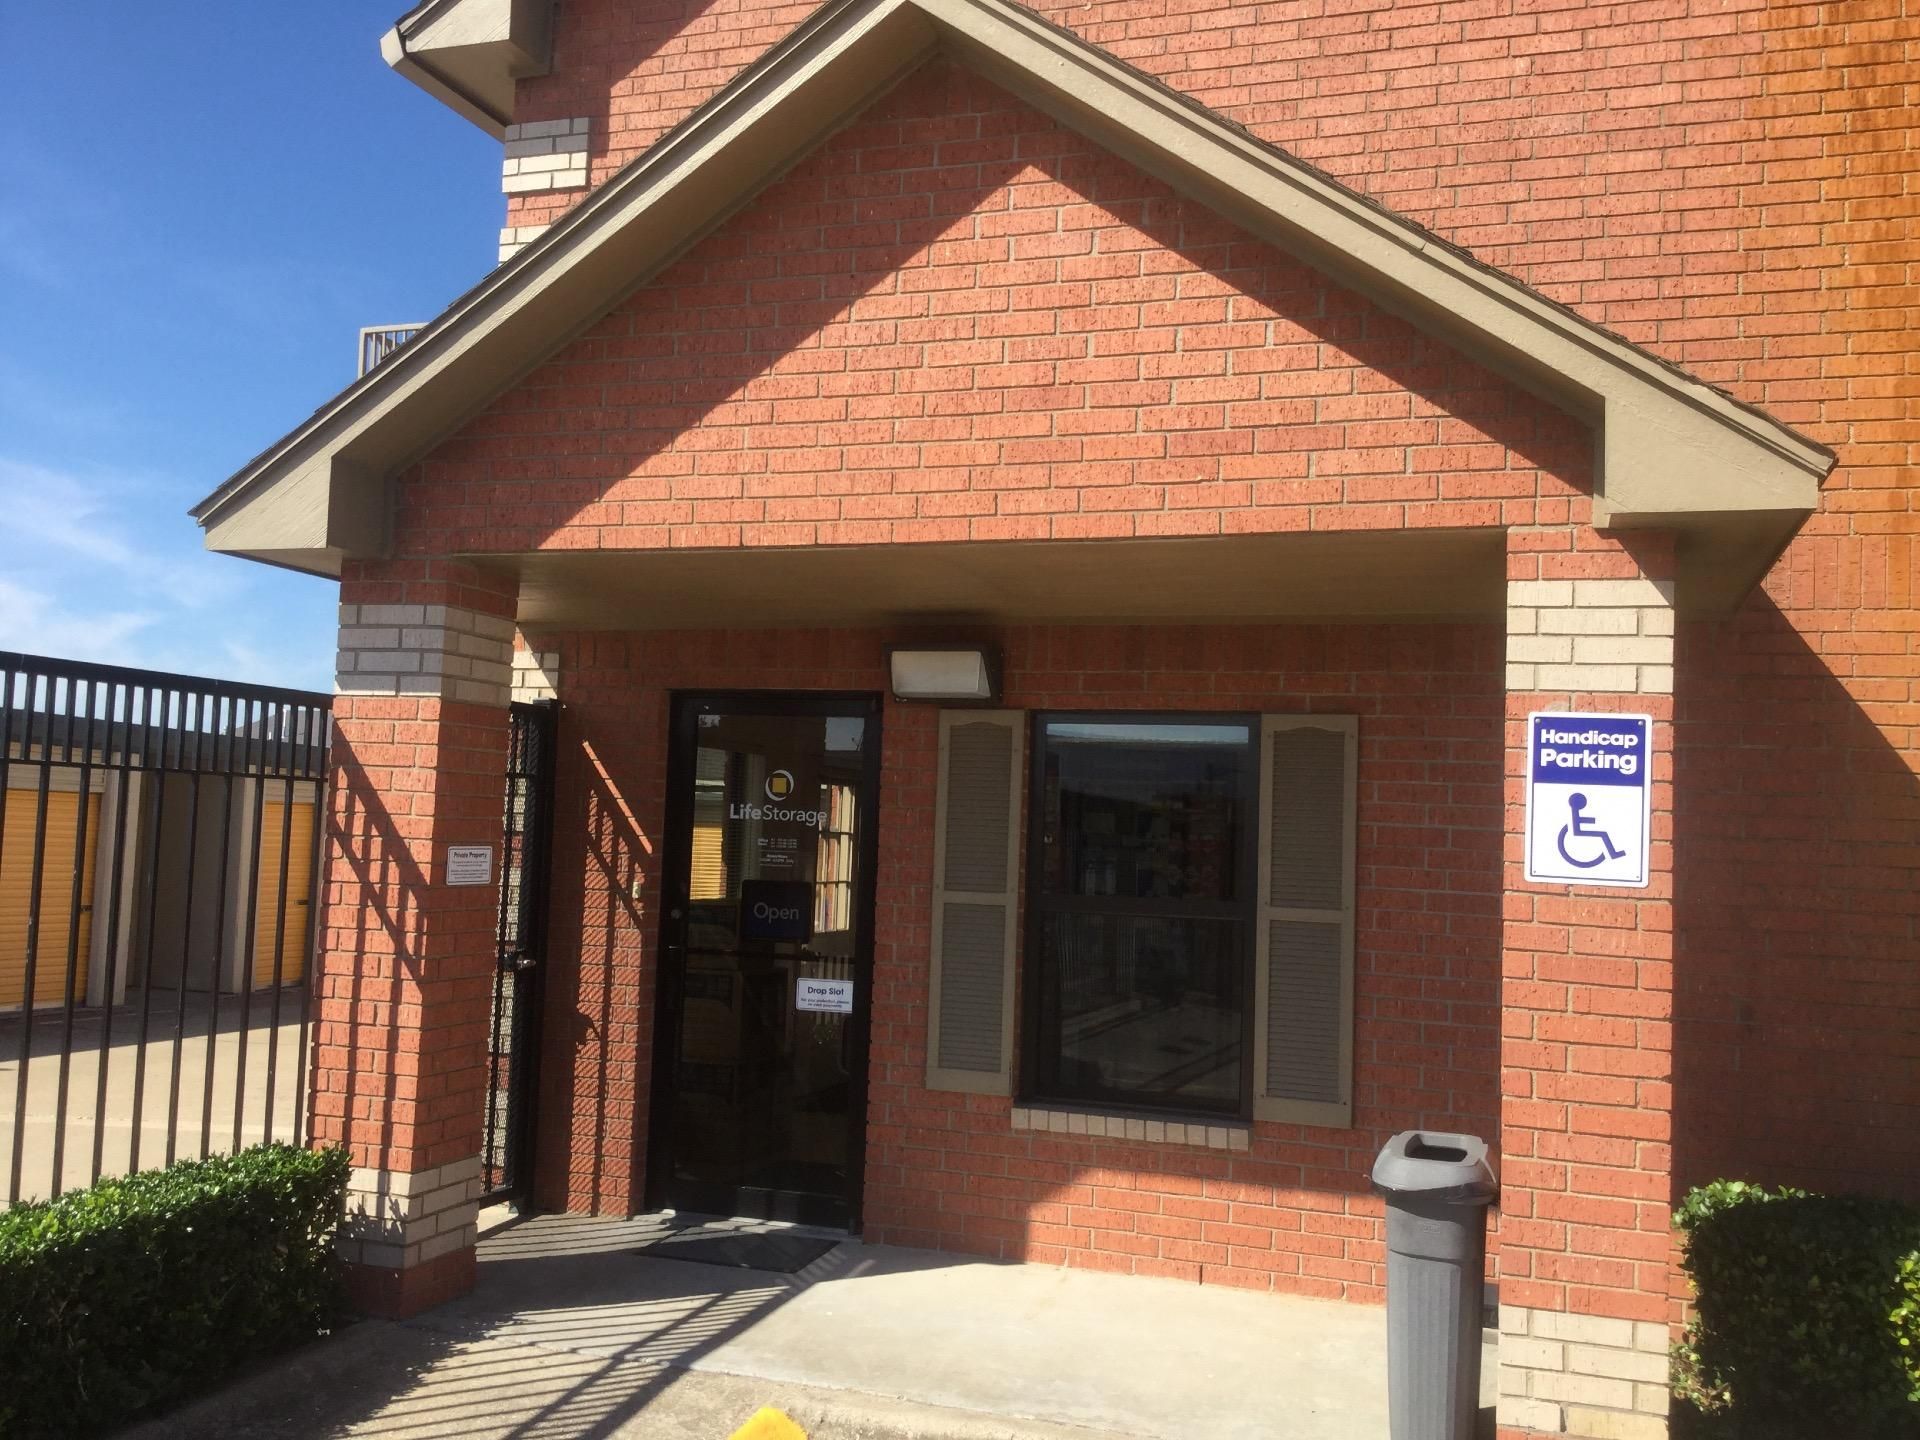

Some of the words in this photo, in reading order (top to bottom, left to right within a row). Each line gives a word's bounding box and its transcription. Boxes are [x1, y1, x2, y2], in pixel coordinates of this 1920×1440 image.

[1540, 729, 1639, 749] Handicap
[1540, 749, 1637, 775] Parking
[753, 902, 799, 925] Open
[807, 986, 827, 996] Drop
[828, 987, 844, 996] Slot
